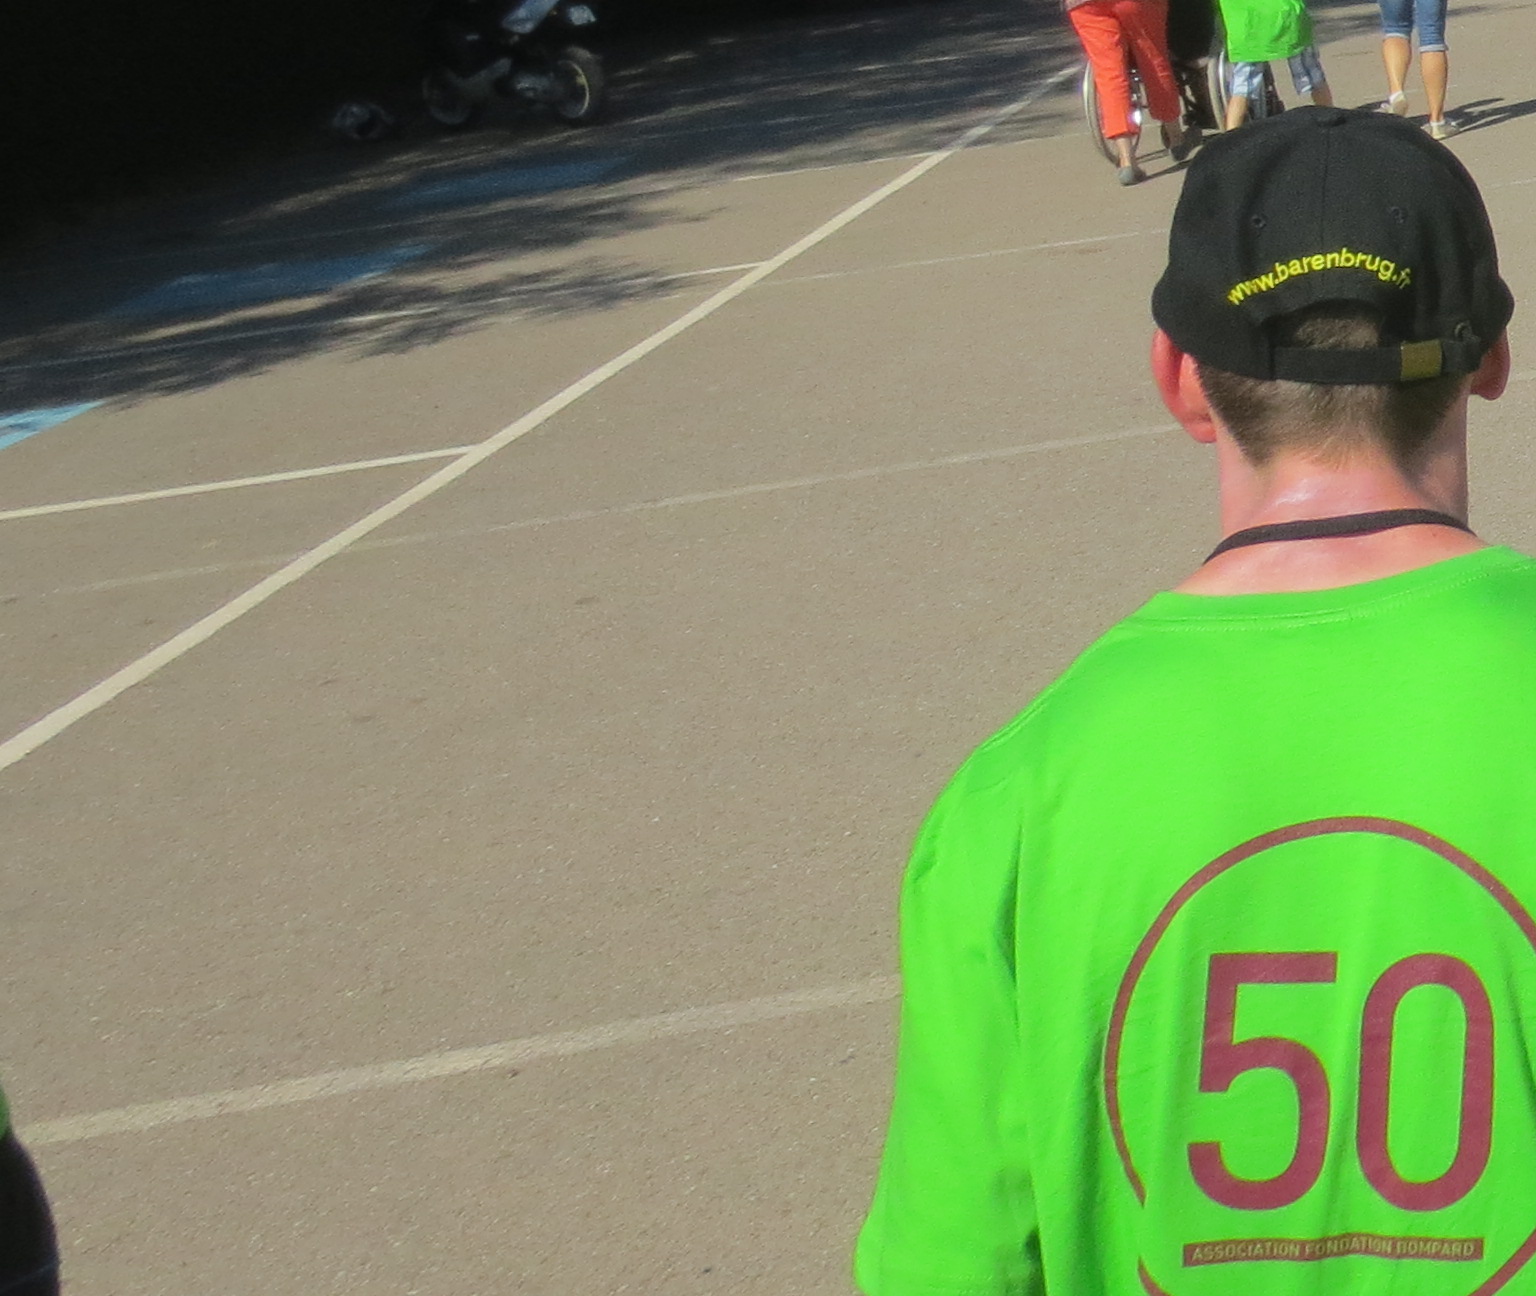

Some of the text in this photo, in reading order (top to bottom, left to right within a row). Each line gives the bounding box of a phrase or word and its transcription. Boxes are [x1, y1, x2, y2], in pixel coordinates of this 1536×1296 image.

[1226, 247, 1411, 306] www.barenbrug.fr
[1187, 951, 1495, 1212] 50
[1191, 1242, 1300, 1263] ASSOCIATION
[1304, 1236, 1393, 1259] FONDATION
